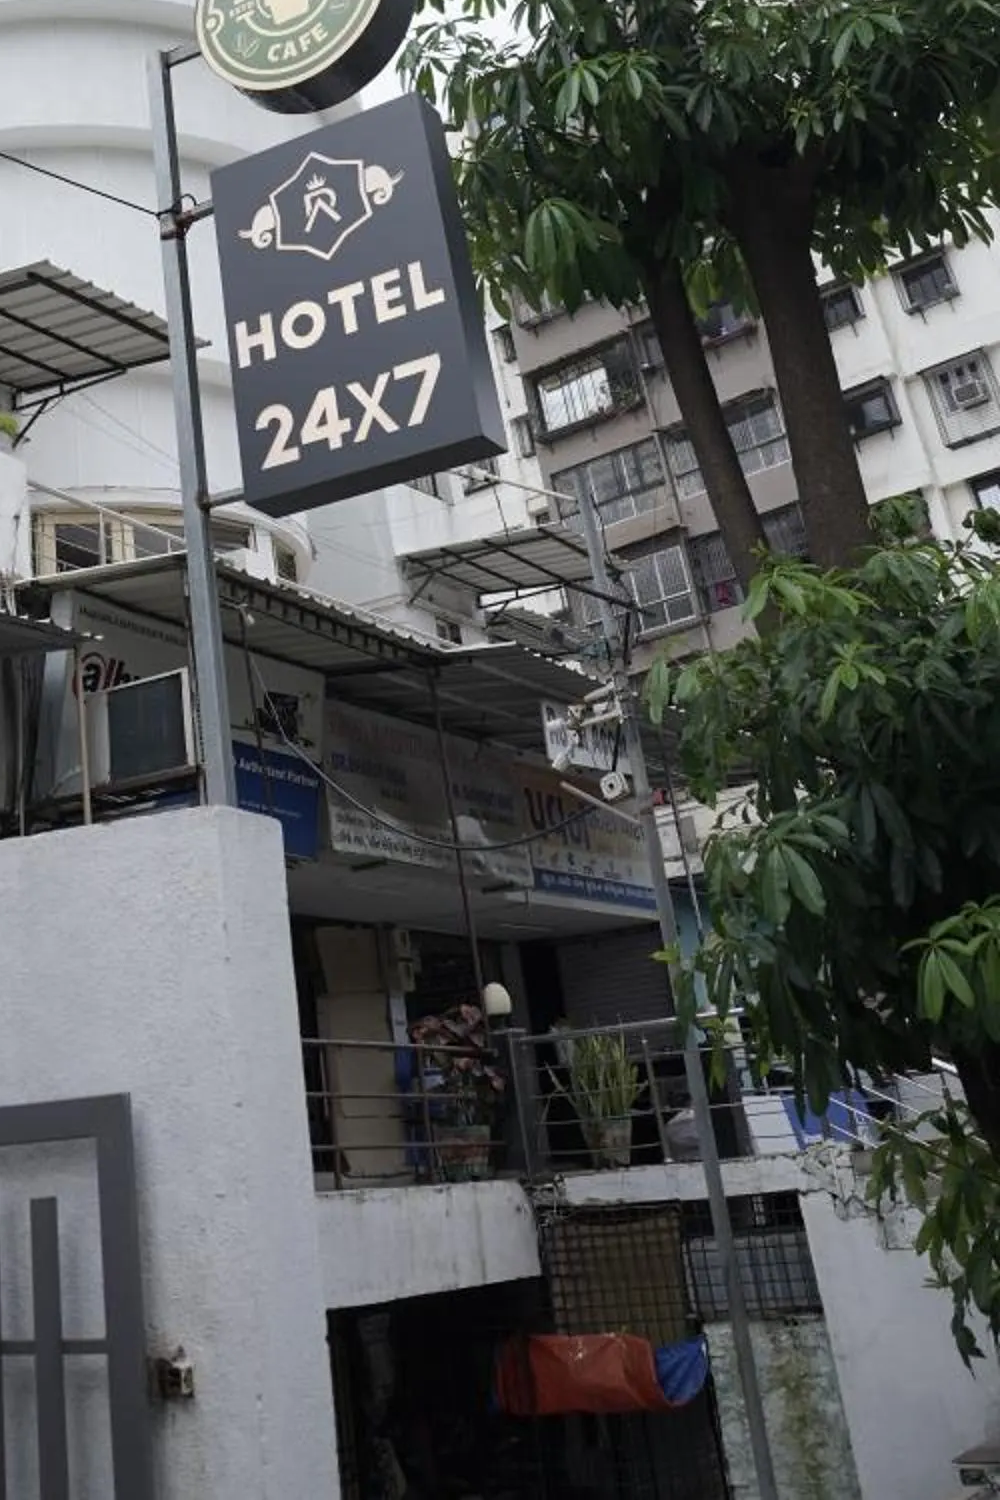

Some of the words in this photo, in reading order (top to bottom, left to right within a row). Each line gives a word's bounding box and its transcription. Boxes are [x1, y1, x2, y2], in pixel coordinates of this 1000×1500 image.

[267, 22, 329, 63] CAFE
[234, 260, 446, 369] HOTEL
[255, 352, 441, 471] 24X7
